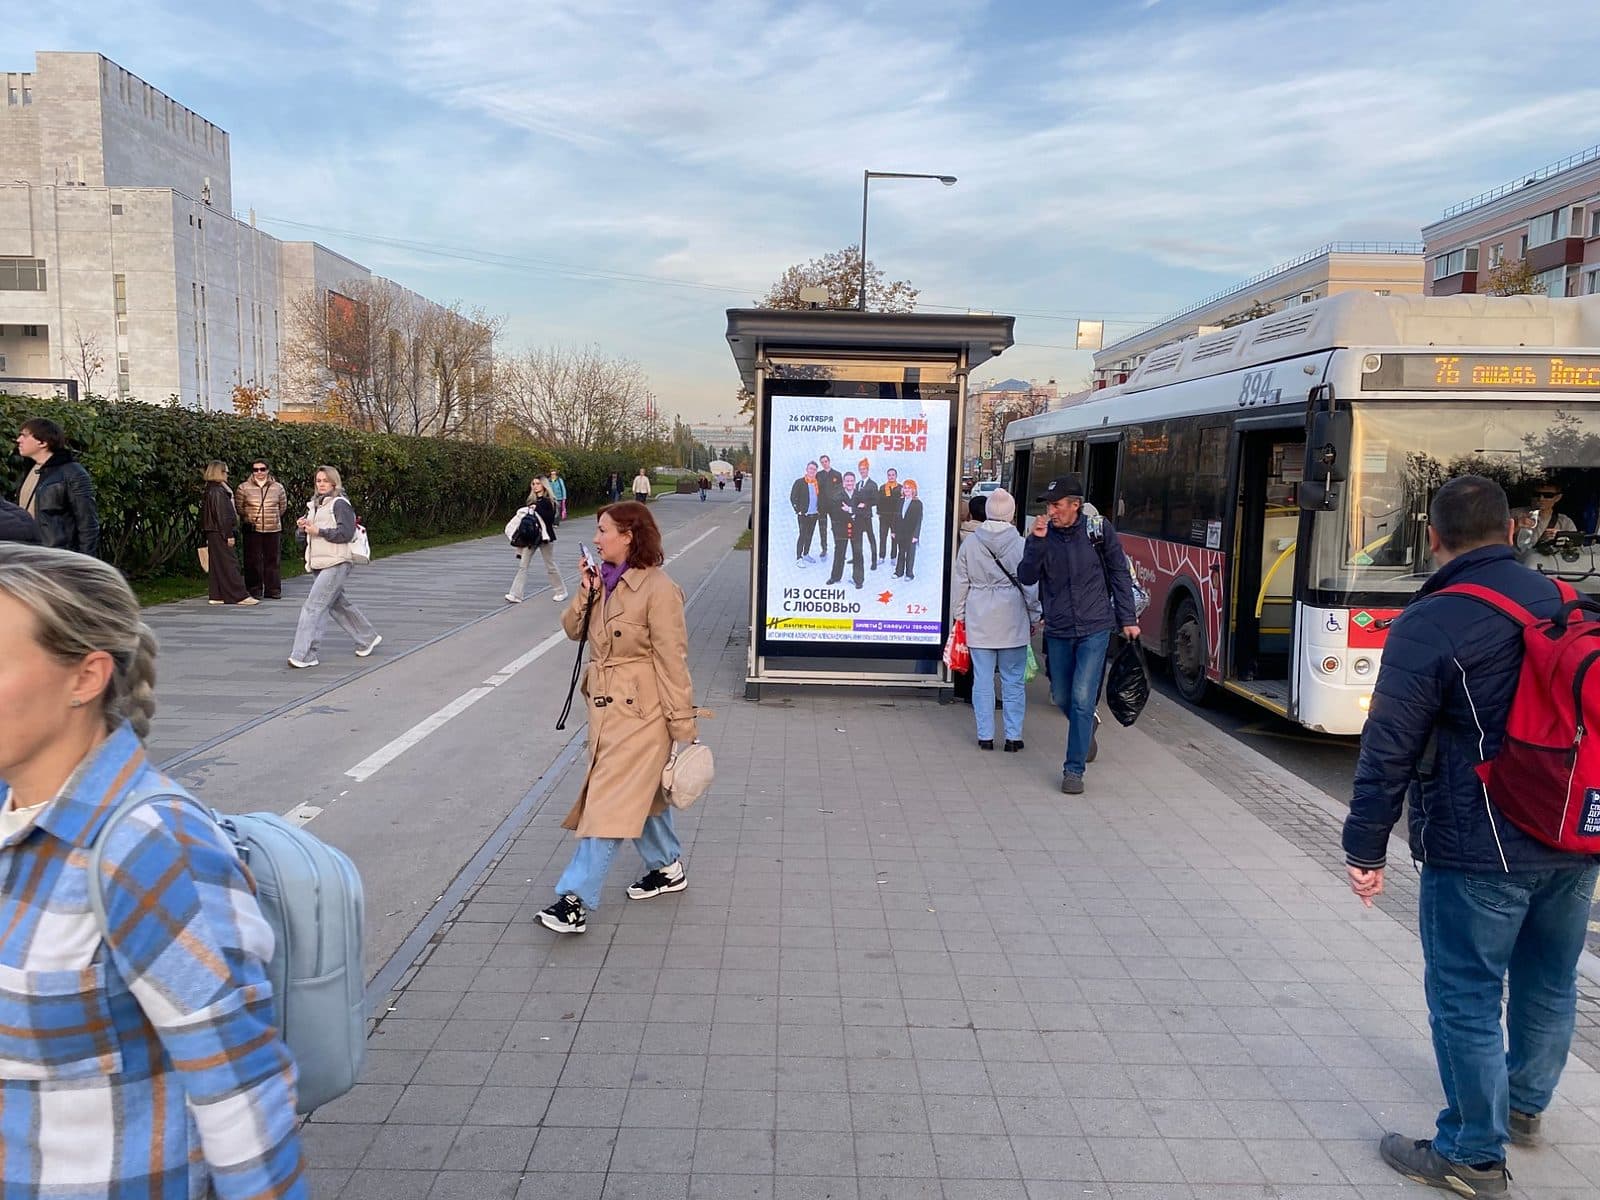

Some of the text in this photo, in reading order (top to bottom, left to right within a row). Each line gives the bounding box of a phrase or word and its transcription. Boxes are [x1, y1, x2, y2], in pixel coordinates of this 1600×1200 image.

[1435, 357, 1459, 384] 76
[1238, 370, 1273, 407] 894
[788, 414, 834, 422] 26 ОКТЯБРЯ
[843, 412, 928, 434] СМИРНЫЙ
[800, 425, 837, 433] ГАГАРИНА
[842, 434, 927, 452] И ДРУЗЬЯ
[783, 588, 846, 600] ИЗ ОСЕНИ
[783, 600, 861, 613] С ЛЮБОВЬЮ
[906, 604, 928, 615] 12+
